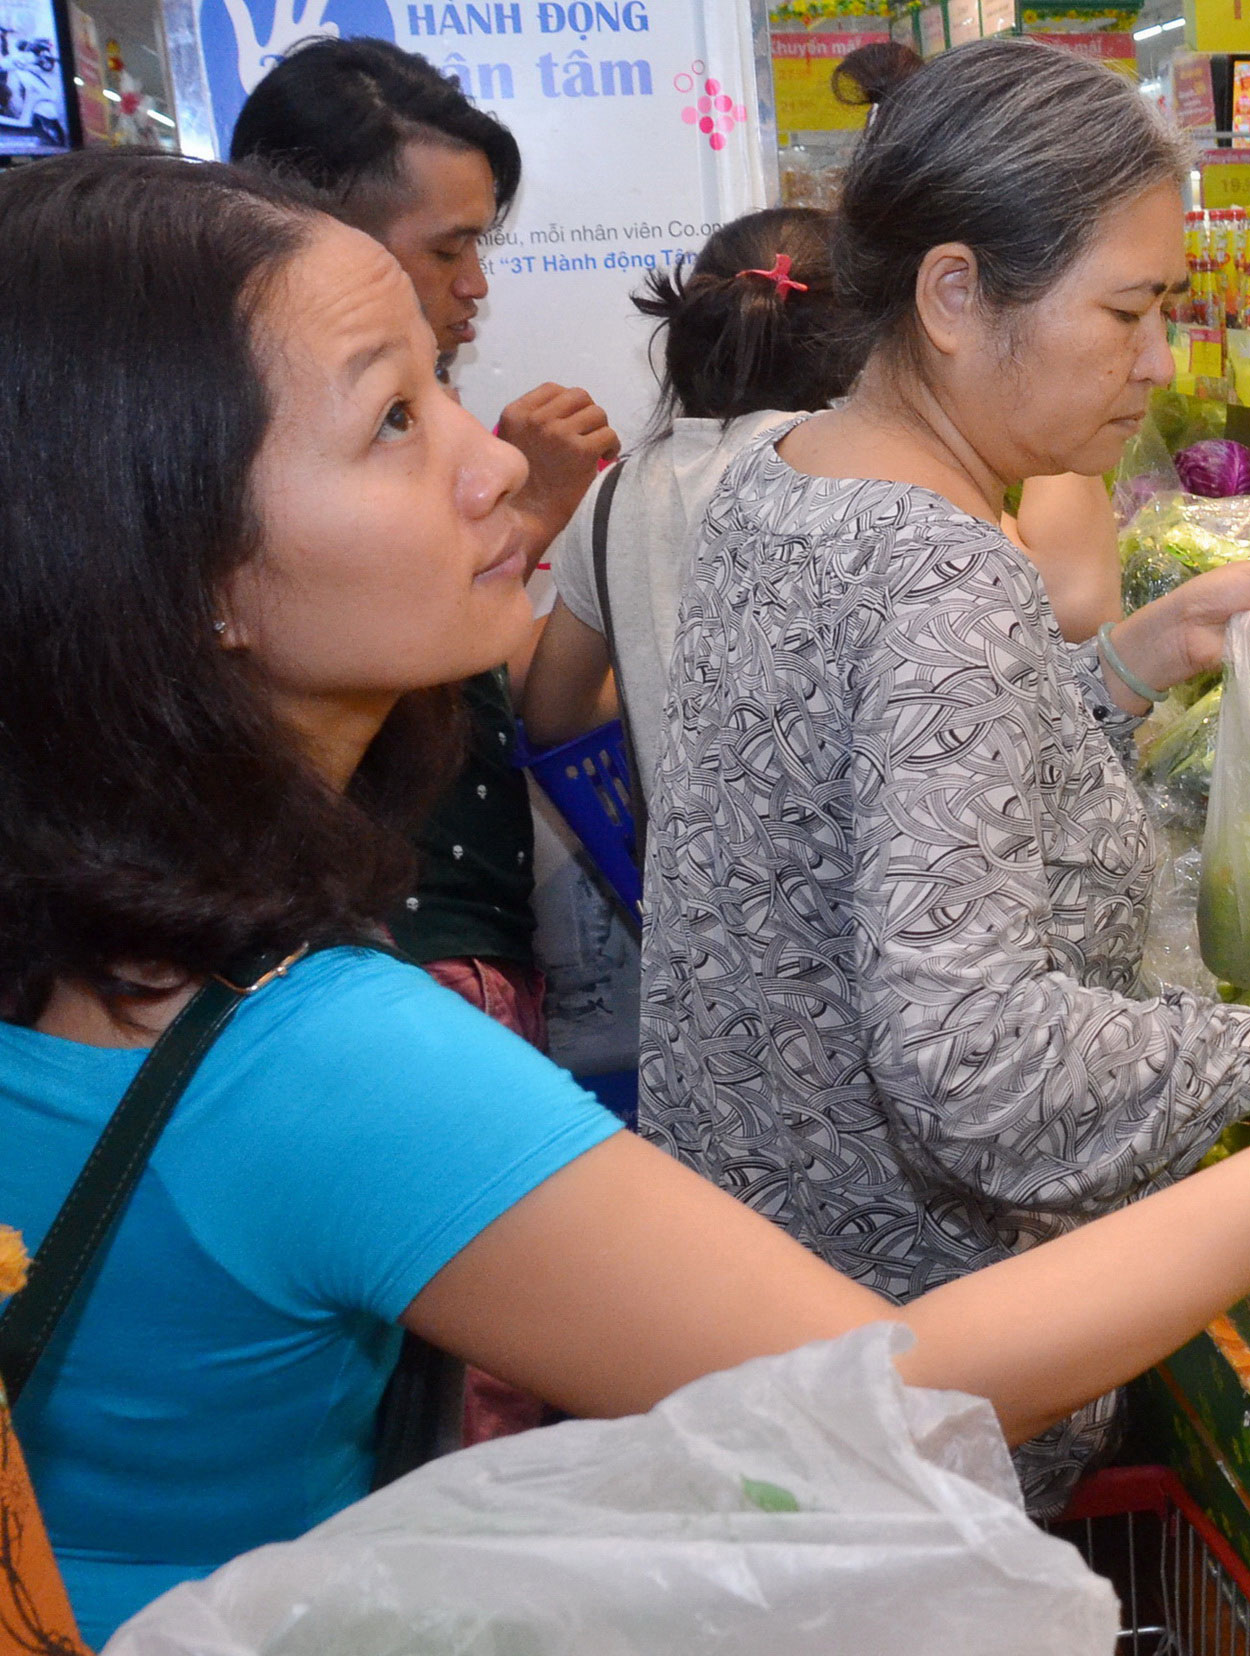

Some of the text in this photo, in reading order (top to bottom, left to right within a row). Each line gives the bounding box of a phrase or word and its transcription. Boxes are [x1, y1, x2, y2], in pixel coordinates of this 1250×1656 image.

[536, 49, 652, 98] tâm
[530, 223, 565, 244] mỗi
[571, 223, 618, 243] nhân
[623, 221, 662, 239] viên
[542, 253, 597, 274] Hành
[603, 249, 656, 273] động
